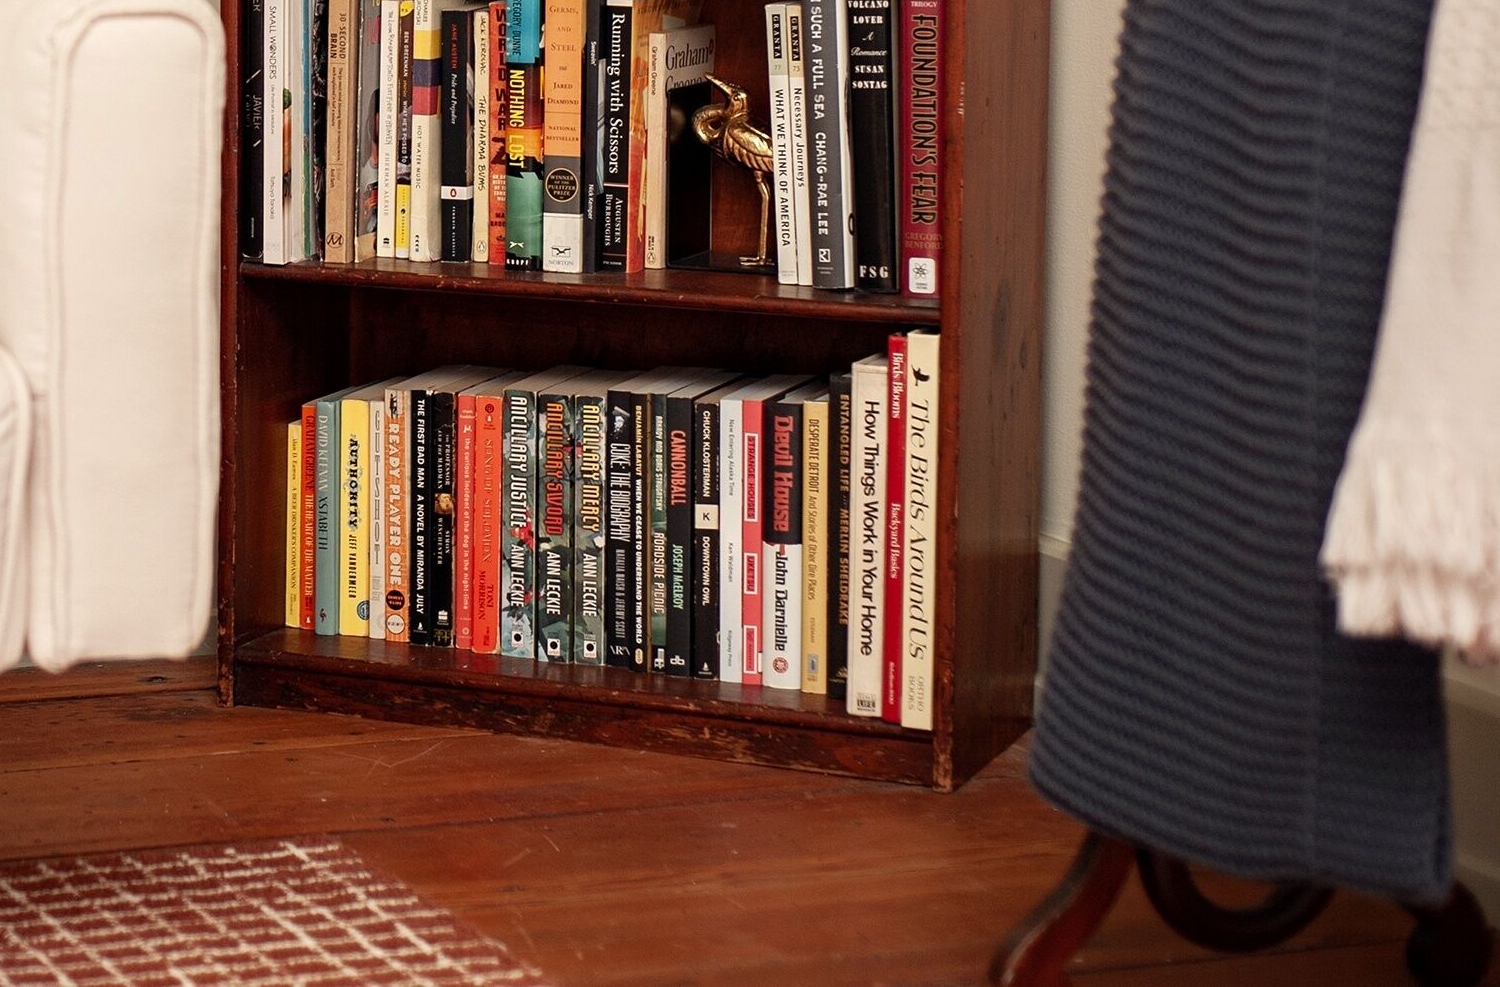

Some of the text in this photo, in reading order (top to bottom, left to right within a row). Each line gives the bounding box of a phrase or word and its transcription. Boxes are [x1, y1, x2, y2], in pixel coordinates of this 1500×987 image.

[549, 5, 579, 15] GERMS,
[810, 6, 823, 39] SUCH
[848, 0, 889, 9] VOLCANO
[853, 16, 883, 24] LOVER
[268, 5, 277, 80] SMALL WONDERS
[330, 33, 338, 59] BRAIN
[511, 30, 522, 56] DUNNE
[550, 43, 576, 52] STEEL
[665, 43, 709, 71] Graham
[812, 43, 823, 53] A
[553, 82, 573, 90] JARED
[812, 58, 824, 90] FULL
[852, 80, 888, 89] SONTAG
[854, 65, 884, 73] SUSAN
[607, 14, 626, 174] Running with Scissors
[814, 94, 825, 120] SEA
[478, 119, 487, 161] DHARMA
[508, 69, 525, 169] NOTHING LOST
[911, 14, 938, 224] FOUNDATION'S FEAR
[477, 164, 486, 192] BUMS
[775, 89, 791, 247] WHAT WE THINK OF AMERICA
[815, 131, 828, 236] CHANG-RAE LEE
[604, 194, 613, 246] BURROUGHS
[614, 198, 624, 244] AUGUSTEN
[389, 423, 399, 482] READY
[509, 396, 528, 528] ANCILLARY JUSTICE
[544, 402, 564, 535] ANCILLARY SWORD
[580, 405, 600, 532] ANCILLARY MERCY
[635, 444, 643, 477] LABATUT
[670, 430, 687, 506] CANNONBALL
[702, 410, 711, 497] CHUCK KLOSTERMAN
[349, 438, 358, 528] AUTHORITY
[416, 399, 425, 614] THE FIRST BAD MAN A NOVEL BY MIRANDA JULY
[610, 442, 631, 542] COKE: THE BIOGRAPHY
[635, 478, 643, 501] WHEN
[389, 483, 401, 547] PLAYER
[635, 502, 643, 514] WE
[635, 515, 643, 540] CEASE
[860, 400, 880, 657] How Things Work in Your Home
[908, 398, 931, 660] The Birds Around Us
[348, 534, 357, 599] JEFF VANDERMEER
[390, 552, 401, 586] ONE
[635, 540, 643, 551] TO
[511, 544, 525, 607] ANN LECKIE
[546, 551, 561, 615] ANN LECKIE
[583, 553, 597, 617] ANN LECKIE
[635, 551, 643, 600] UNDERSTAND
[702, 536, 711, 606] DOWNTOWN OWL
[635, 601, 643, 617] THE
[775, 551, 789, 652] John Darnielle
[635, 618, 643, 644] WORLD
